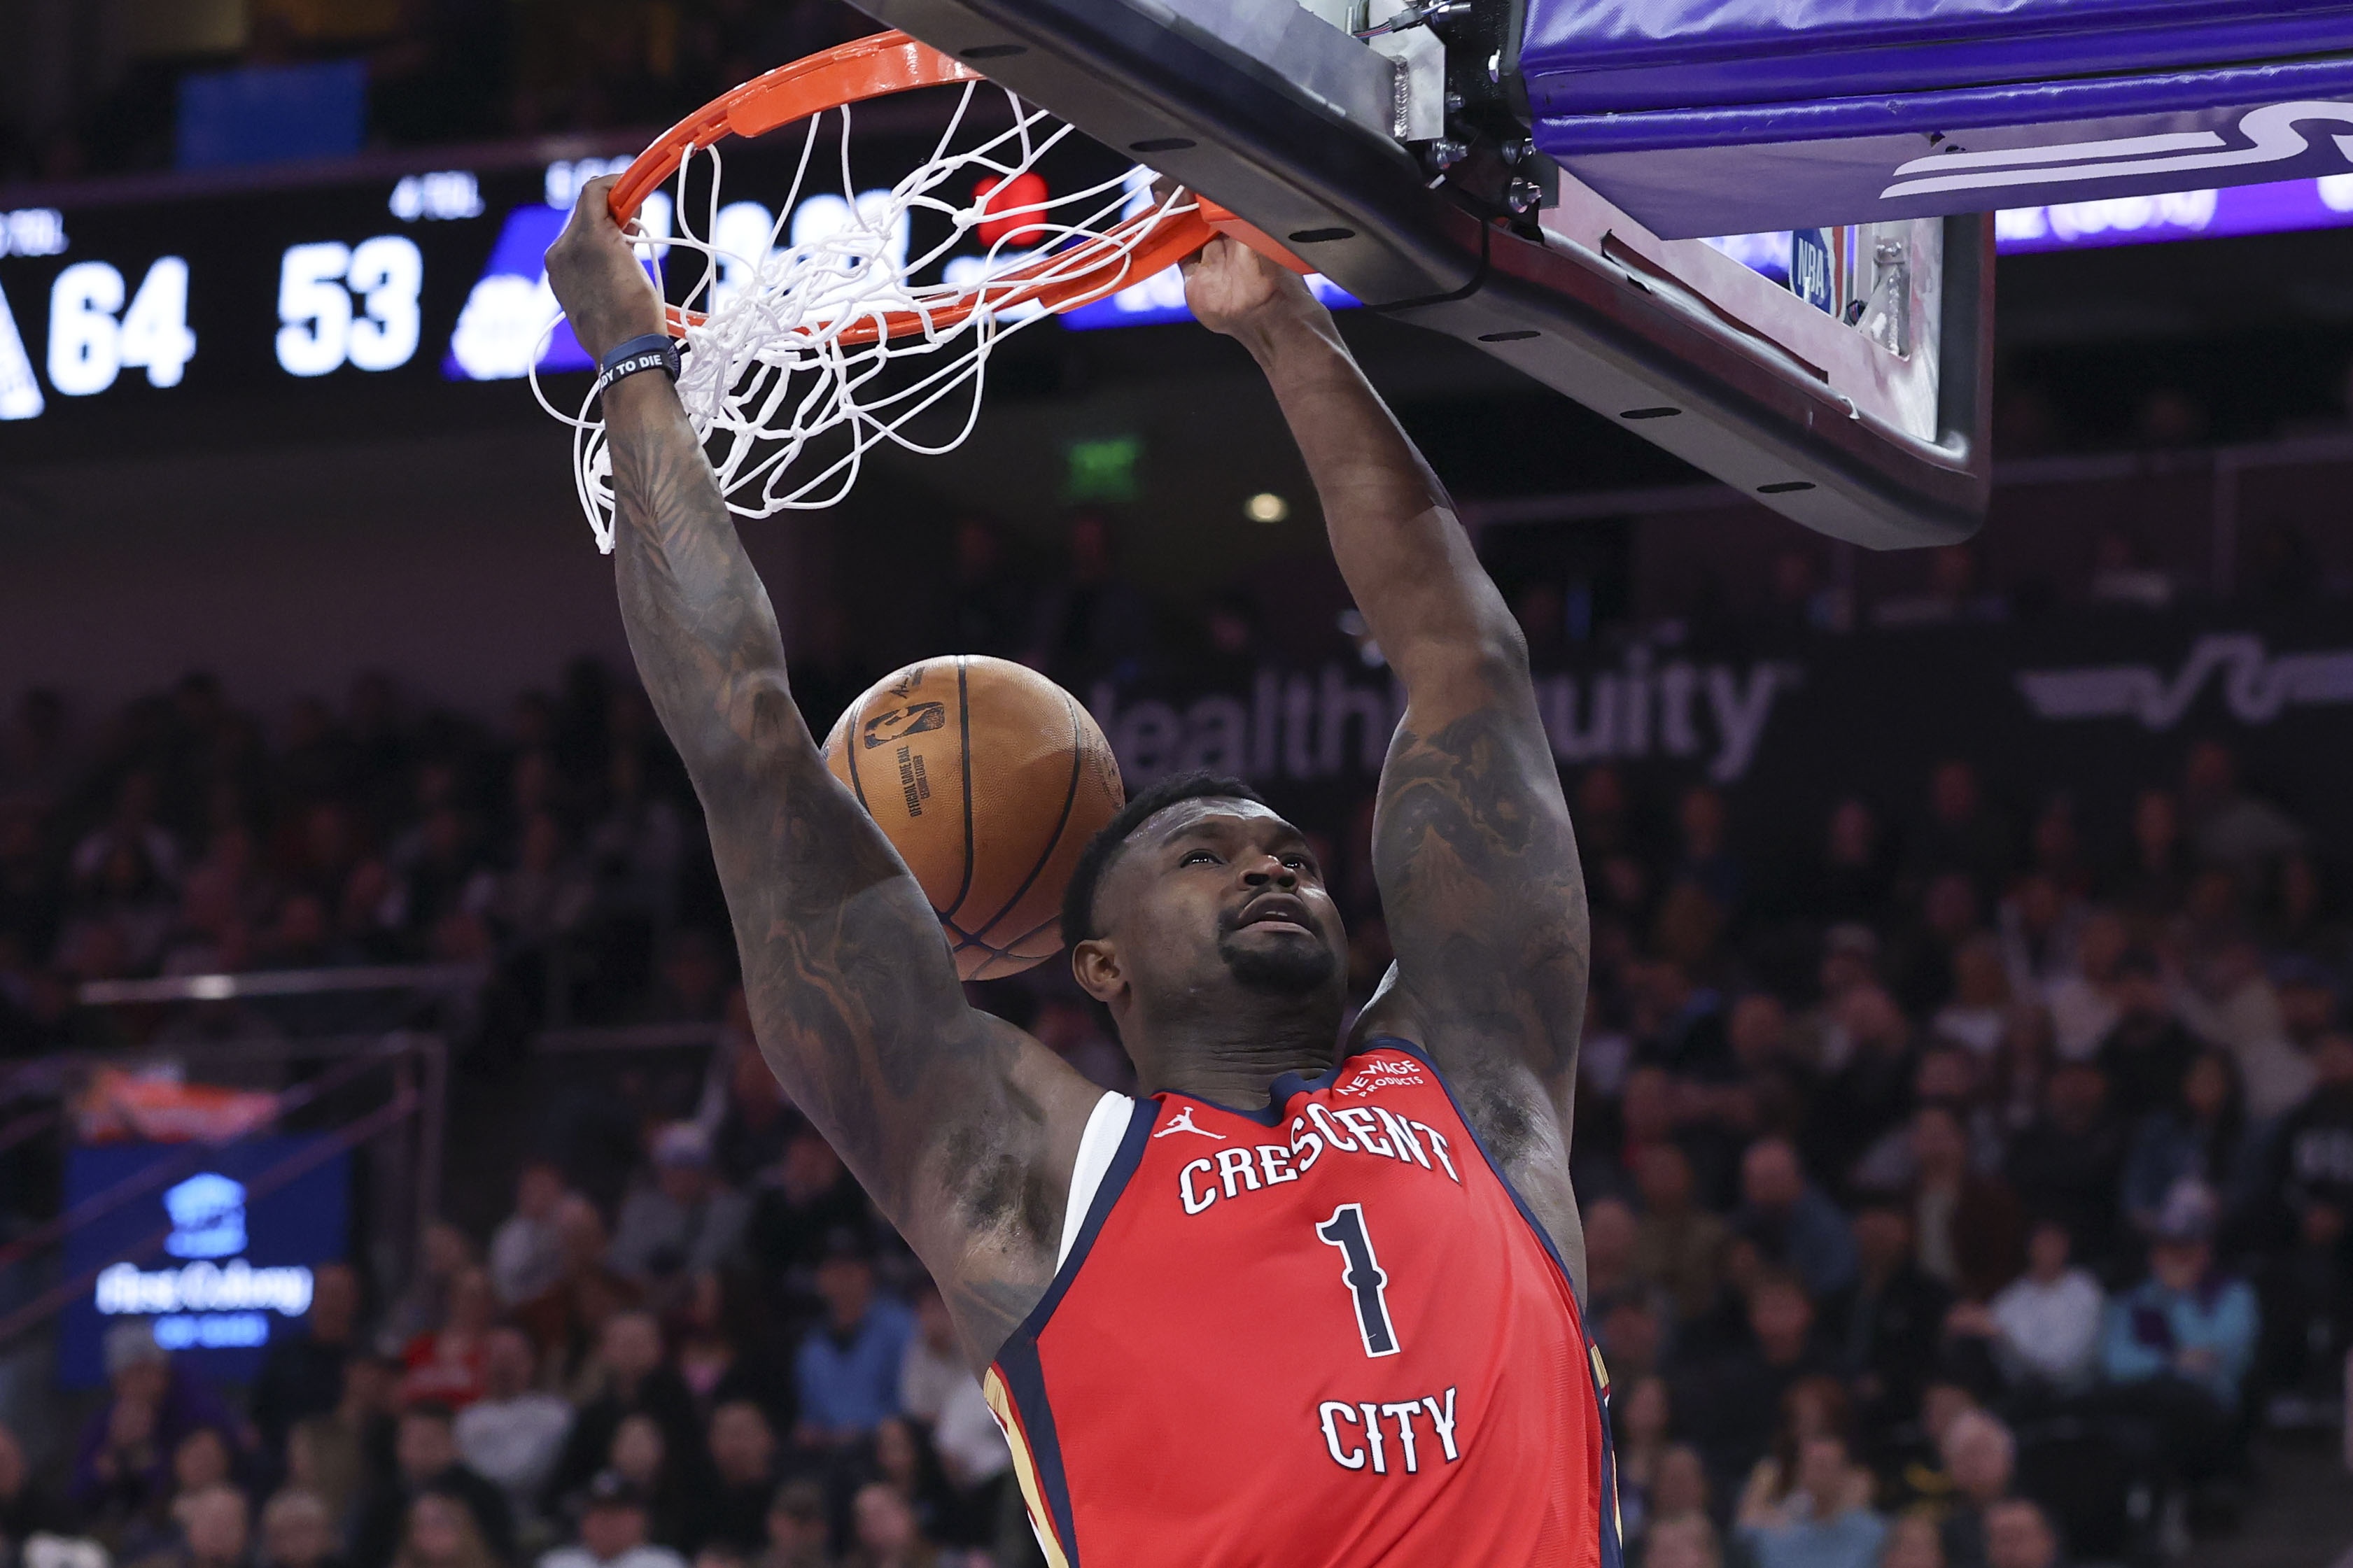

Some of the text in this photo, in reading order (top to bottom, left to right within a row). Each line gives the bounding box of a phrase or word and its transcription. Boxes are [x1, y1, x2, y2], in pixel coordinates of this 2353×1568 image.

[276, 235, 423, 376] 53
[1797, 236, 1825, 299] NBA
[47, 256, 197, 396] 64
[616, 360, 636, 376] TO
[638, 354, 663, 369] DIE
[897, 744, 922, 818] OFFICIAL GAME BALL
[1357, 1075, 1424, 1098] PRODUCTS
[1179, 1101, 1462, 1216] CRESCENT
[1315, 1202, 1401, 1358] 1
[1318, 1385, 1460, 1475] CITY
